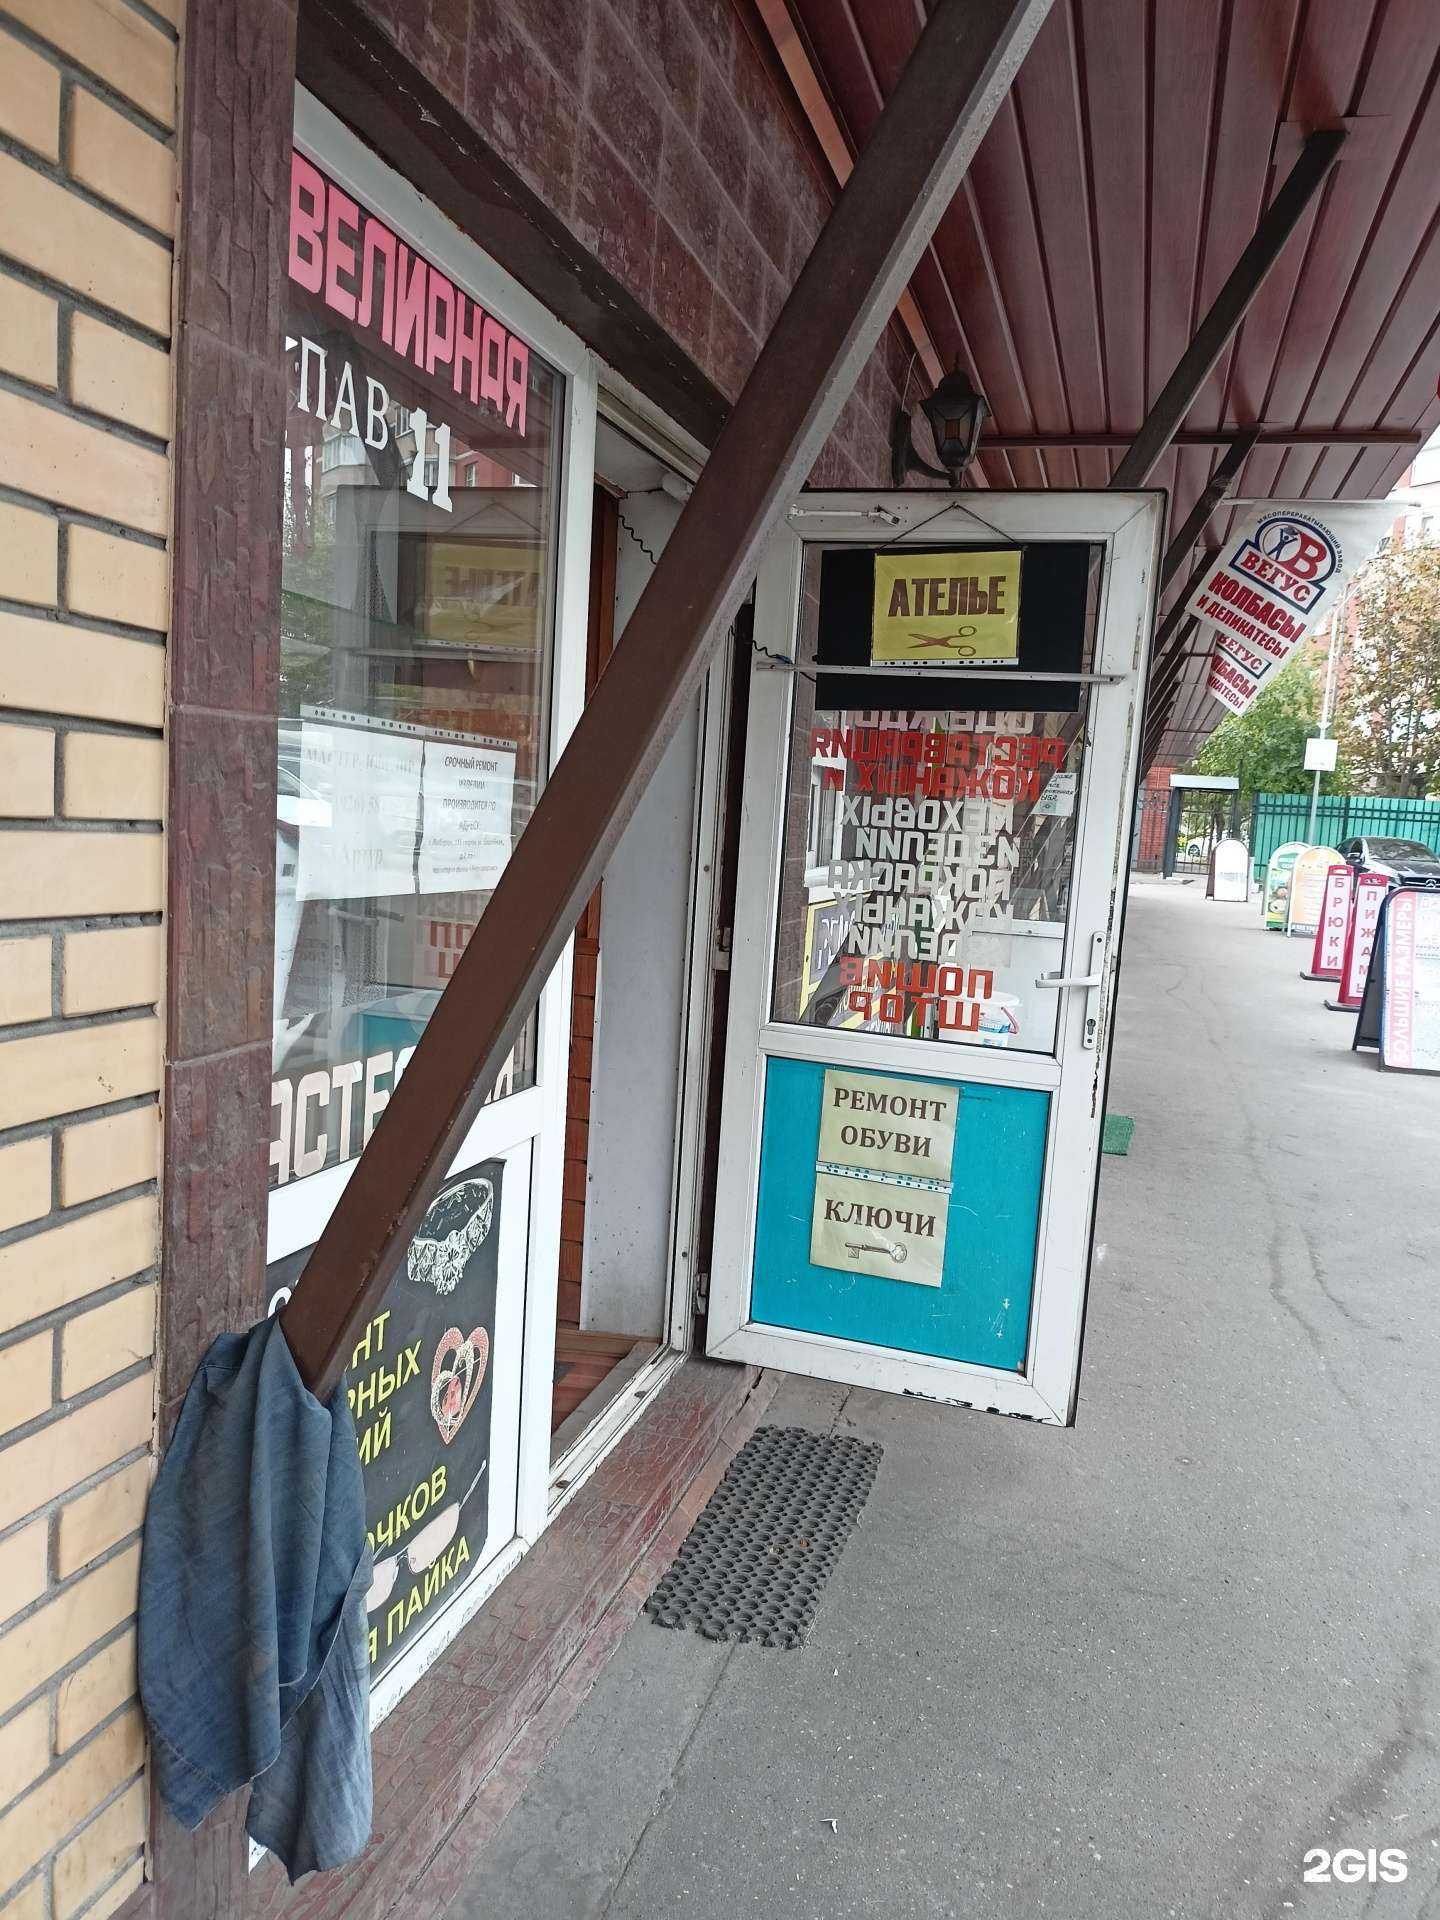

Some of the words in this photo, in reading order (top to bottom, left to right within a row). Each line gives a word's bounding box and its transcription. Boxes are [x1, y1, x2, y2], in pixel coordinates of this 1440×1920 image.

[288, 151, 529, 437] ВЕЛИРНАЯ
[298, 336, 390, 450] ПАВ
[888, 575, 1006, 617] АТЕЛЬЕ
[1240, 551, 1310, 602] ВЕГУС
[1196, 594, 1207, 607] И
[1205, 600, 1290, 660] ДЕЛИКАТЕСЫ
[1207, 571, 1306, 643] КОЛБАСЫ
[475, 761, 498, 773] РЕМОНТ
[1326, 877, 1345, 967] БРЮКИ
[833, 1087, 947, 1122] РЕМОНТ
[840, 1125, 932, 1158] ОБУВИ
[824, 1199, 937, 1237] КЛЮЧИ
[387, 1535, 470, 1647] ПАЙКА
